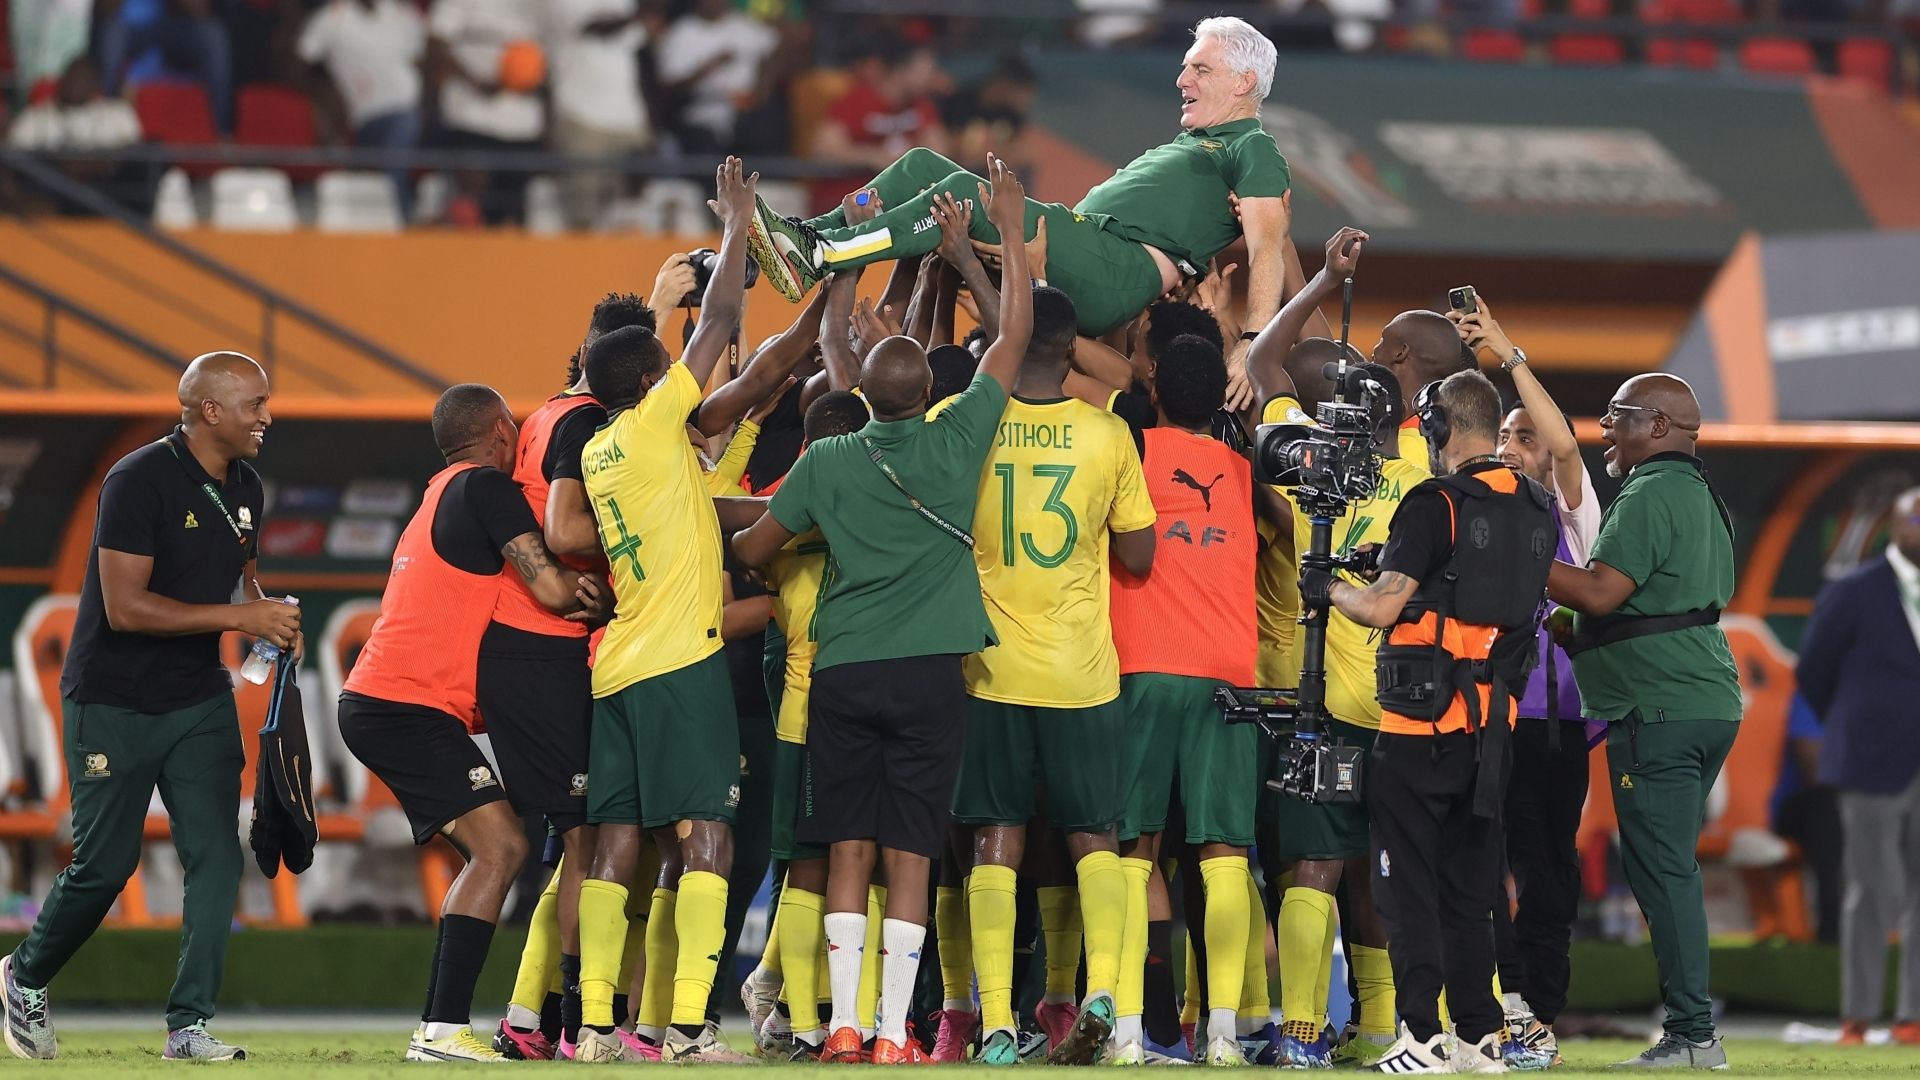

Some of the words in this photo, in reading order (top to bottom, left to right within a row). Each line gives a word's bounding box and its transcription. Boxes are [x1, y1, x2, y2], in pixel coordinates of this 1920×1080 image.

[913, 213, 939, 234] ORTIF
[998, 421, 1073, 449] SITHOLE
[1377, 478, 1400, 502] BA
[918, 505, 939, 521] NATIONS
[936, 517, 944, 525] OF
[994, 463, 1078, 569] 13
[942, 521, 952, 530] CUP
[594, 497, 646, 581] 4
